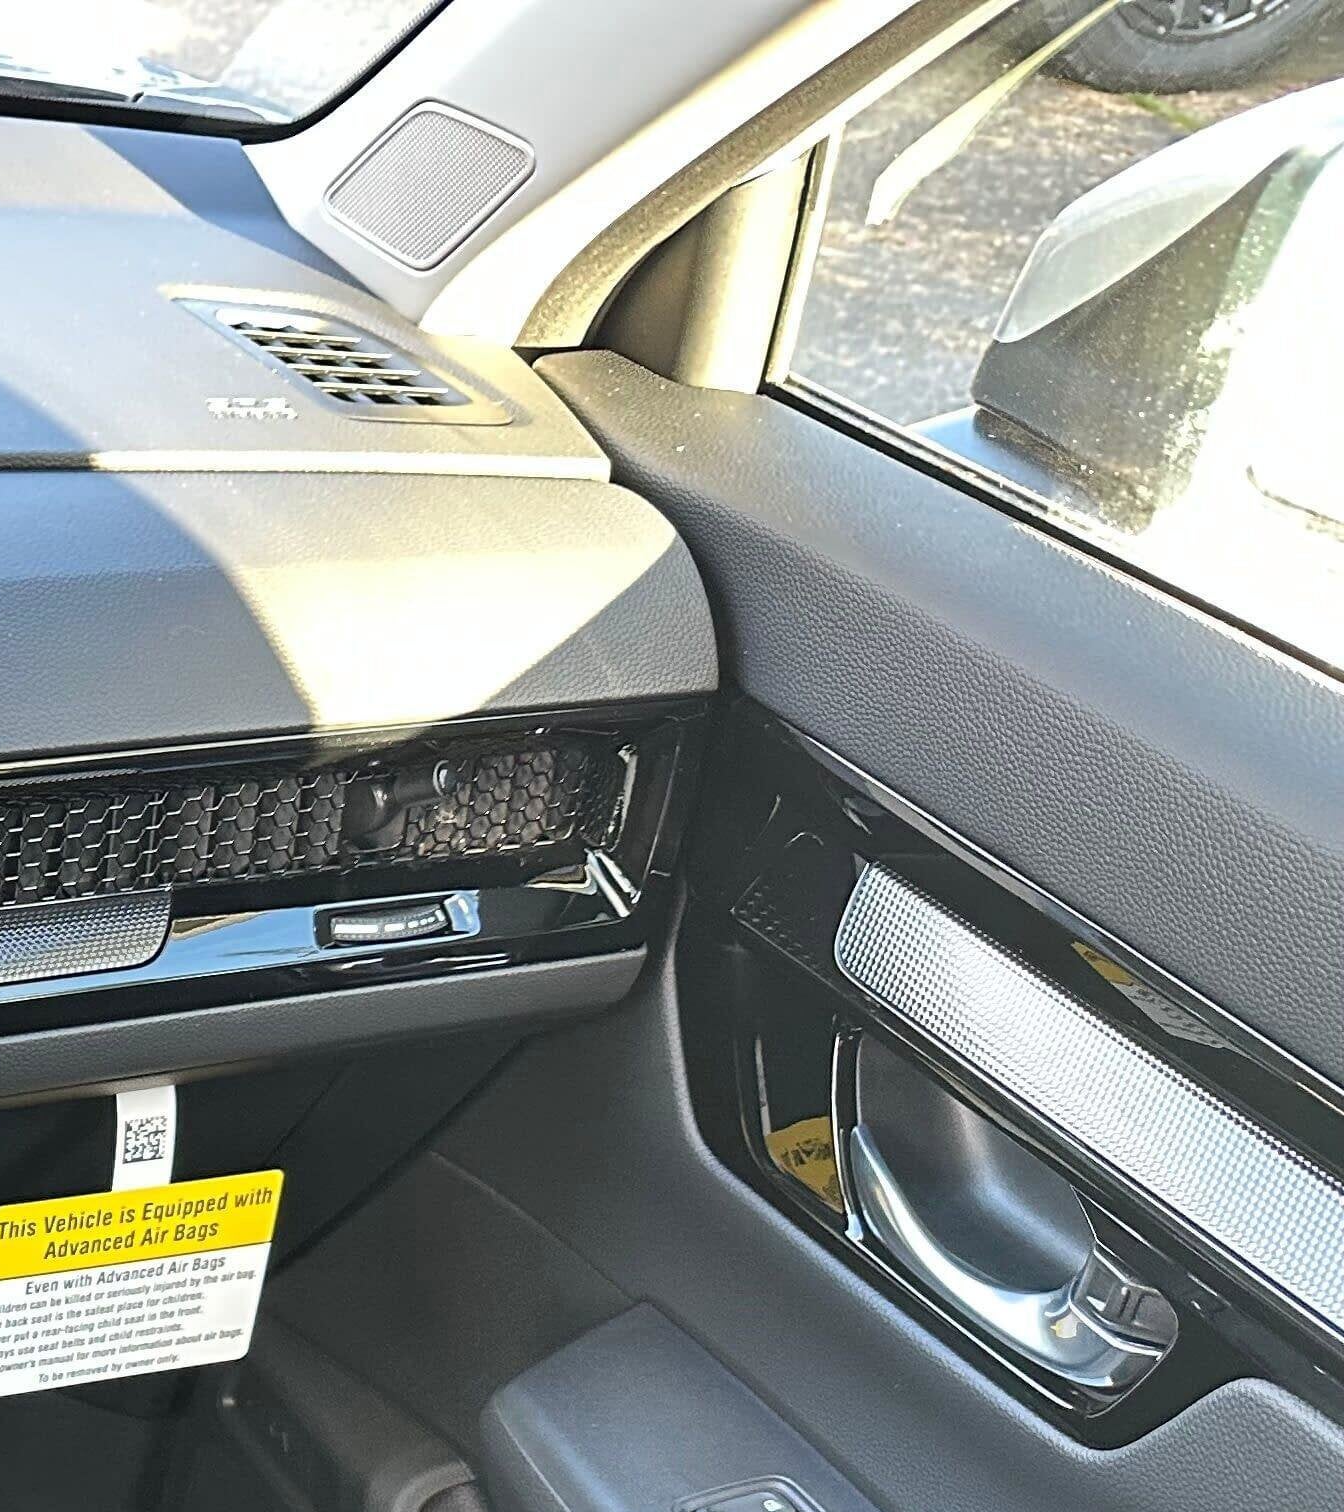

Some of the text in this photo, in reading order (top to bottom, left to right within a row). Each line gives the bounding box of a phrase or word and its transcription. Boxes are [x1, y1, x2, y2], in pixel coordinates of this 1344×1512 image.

[44, 1209, 112, 1233] Vehicle
[119, 1206, 135, 1224] is
[142, 1192, 229, 1222] Equipped
[235, 1186, 273, 1208] with
[43, 1222, 220, 1260] Advanced Air Bags
[26, 1256, 226, 1295] Even with Advanced Air Bags
[50, 1298, 62, 1307] be
[64, 1293, 91, 1305] killed
[94, 1292, 105, 1301] or
[107, 1285, 151, 1299] seriously
[153, 1280, 187, 1294] injured
[189, 1276, 202, 1287] by
[203, 1274, 218, 1285] the
[220, 1272, 235, 1282] air
[5, 1317, 28, 1329] back
[31, 1314, 52, 1325] seat
[55, 1312, 63, 1321] is
[67, 1308, 82, 1319] the
[85, 1305, 114, 1317] safest
[117, 1301, 143, 1313] place
[146, 1298, 159, 1307] for
[162, 1292, 205, 1306] children.
[14, 1331, 29, 1343] put
[32, 1331, 38, 1339] a
[41, 1321, 95, 1338] rear-facing
[97, 1316, 121, 1329] child
[124, 1314, 145, 1325] seat
[148, 1312, 157, 1321] in
[160, 1309, 175, 1319] the
[0, 1360, 36, 1372] owner's
[39, 1353, 74, 1366] manual
[77, 1351, 90, 1361] for
[91, 1348, 116, 1358] more
[175, 1333, 202, 1346] about
[204, 1331, 217, 1341] air
[18, 1345, 35, 1355] use
[38, 1341, 59, 1352] seat
[62, 1337, 85, 1349] belts
[88, 1335, 106, 1345] and
[109, 1329, 133, 1342] child
[39, 1374, 48, 1383] To
[52, 1372, 63, 1381] be
[67, 1365, 108, 1378] removed
[111, 1362, 122, 1373] by
[125, 1358, 155, 1369] owner
